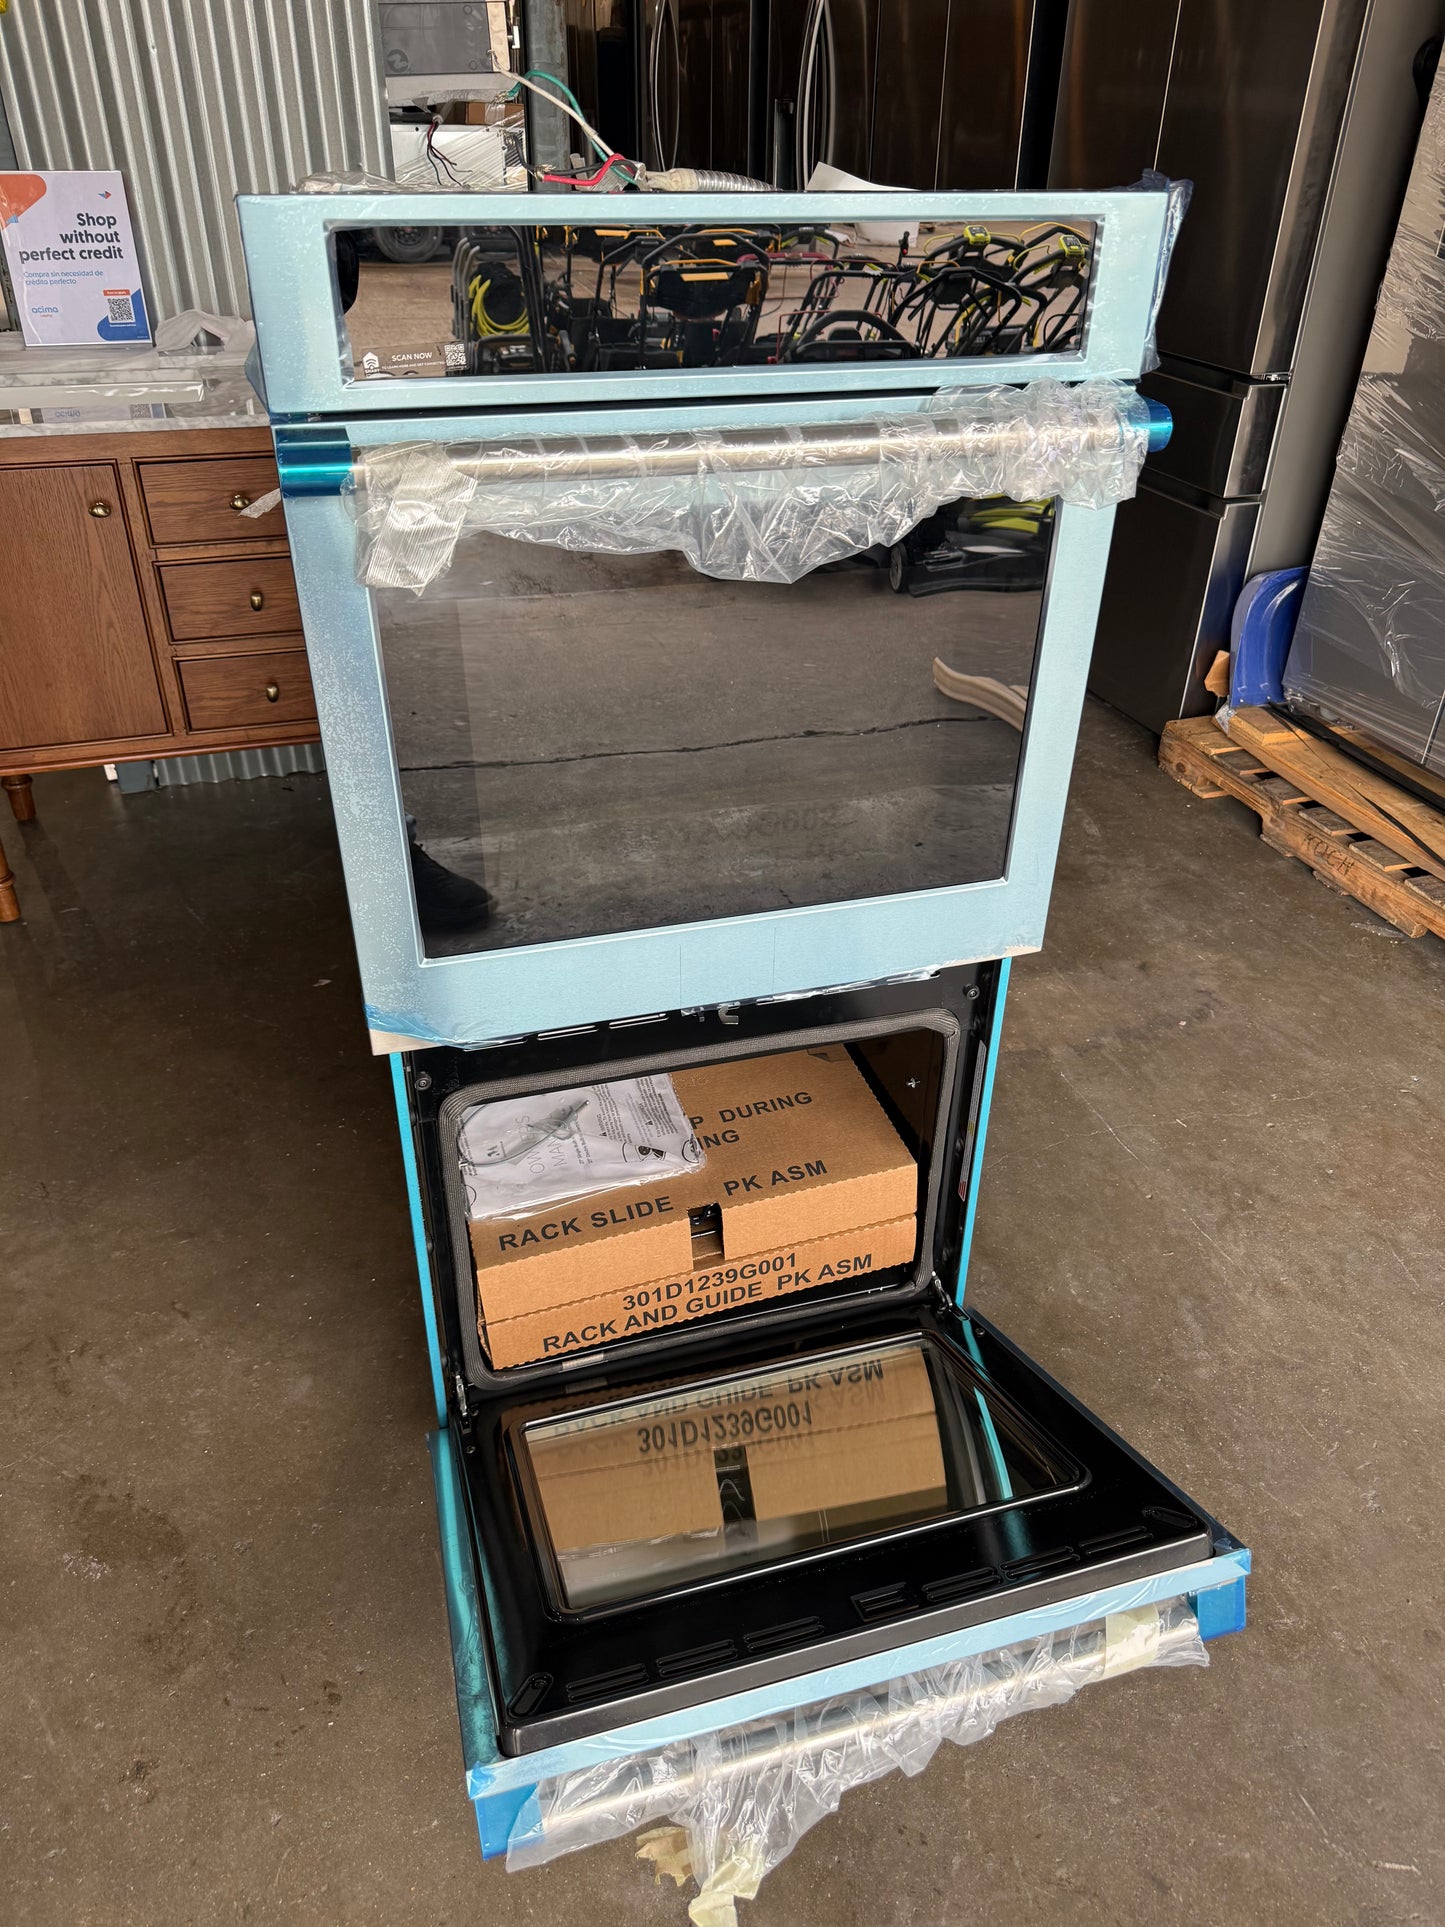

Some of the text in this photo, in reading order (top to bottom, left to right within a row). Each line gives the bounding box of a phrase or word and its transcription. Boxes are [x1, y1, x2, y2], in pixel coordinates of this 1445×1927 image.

[77, 212, 117, 229] Shop
[59, 230, 120, 244] without
[19, 246, 123, 264] perfect credit
[24, 271, 49, 280] Compra
[49, 278, 77, 286] perfecto
[31, 305, 59, 314] acima
[391, 352, 433, 362] SCAN NOW
[719, 1090, 813, 1123] DURING
[498, 1159, 828, 1251] RACK SLIDE PK ASM
[622, 1253, 798, 1311] 301D1239G001
[542, 1253, 874, 1353] RACK AND GUIDE PK ASM
